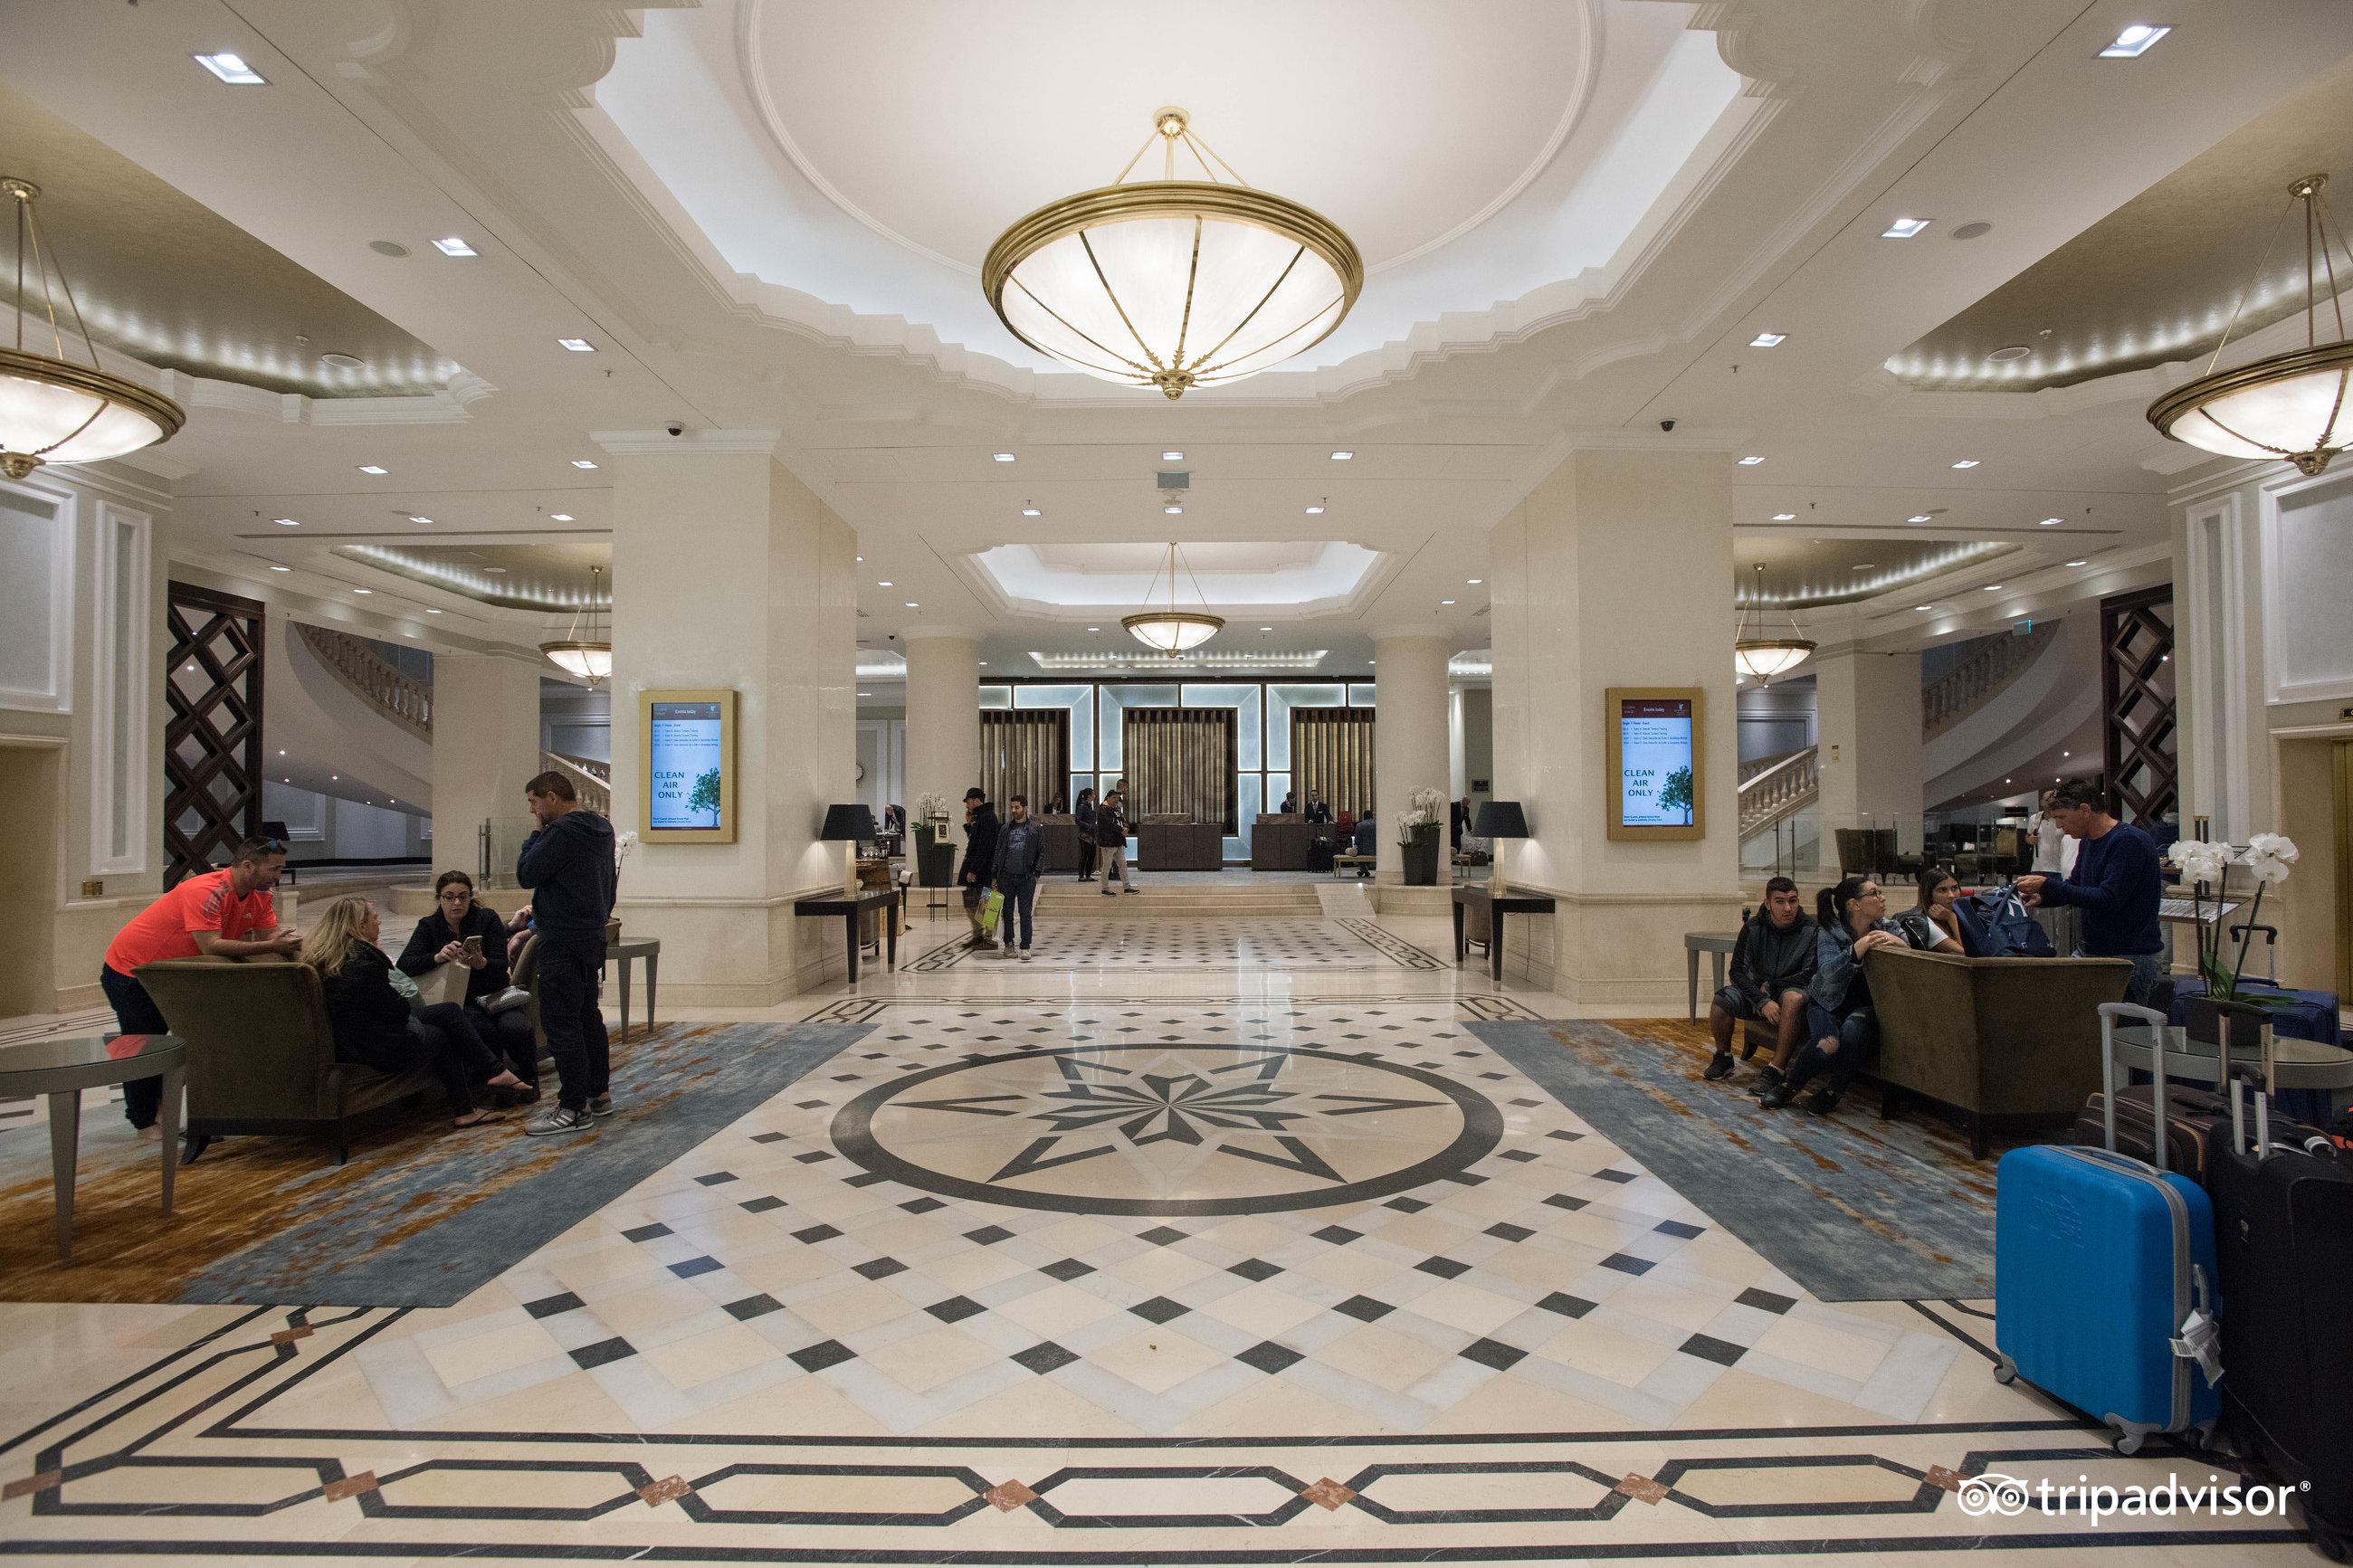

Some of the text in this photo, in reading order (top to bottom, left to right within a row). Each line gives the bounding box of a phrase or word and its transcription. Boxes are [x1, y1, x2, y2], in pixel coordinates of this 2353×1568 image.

[654, 771, 685, 779] CLEAN
[1624, 769, 1654, 777] CLEAN
[1633, 779, 1648, 787] AIR
[1628, 789, 1653, 797] ONLY
